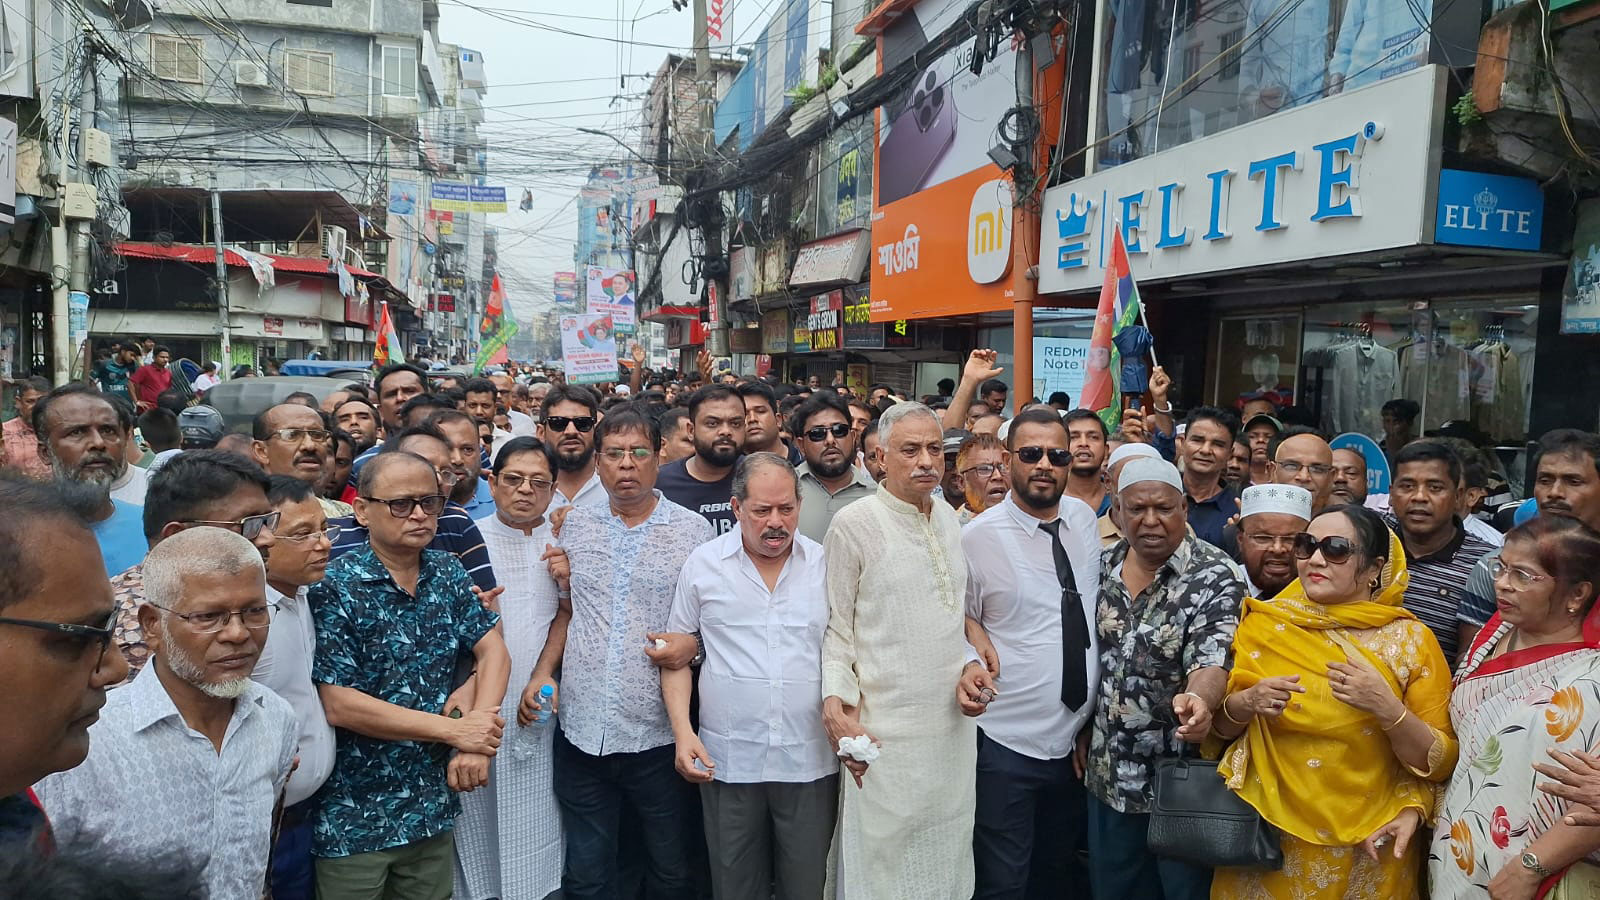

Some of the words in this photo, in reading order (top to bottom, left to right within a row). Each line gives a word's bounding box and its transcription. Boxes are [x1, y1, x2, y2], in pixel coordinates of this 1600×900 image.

[1117, 132, 1362, 254] ELITE
[1443, 204, 1531, 234] ELITE
[1044, 346, 1086, 357] REDMI
[1043, 358, 1079, 370] Note
